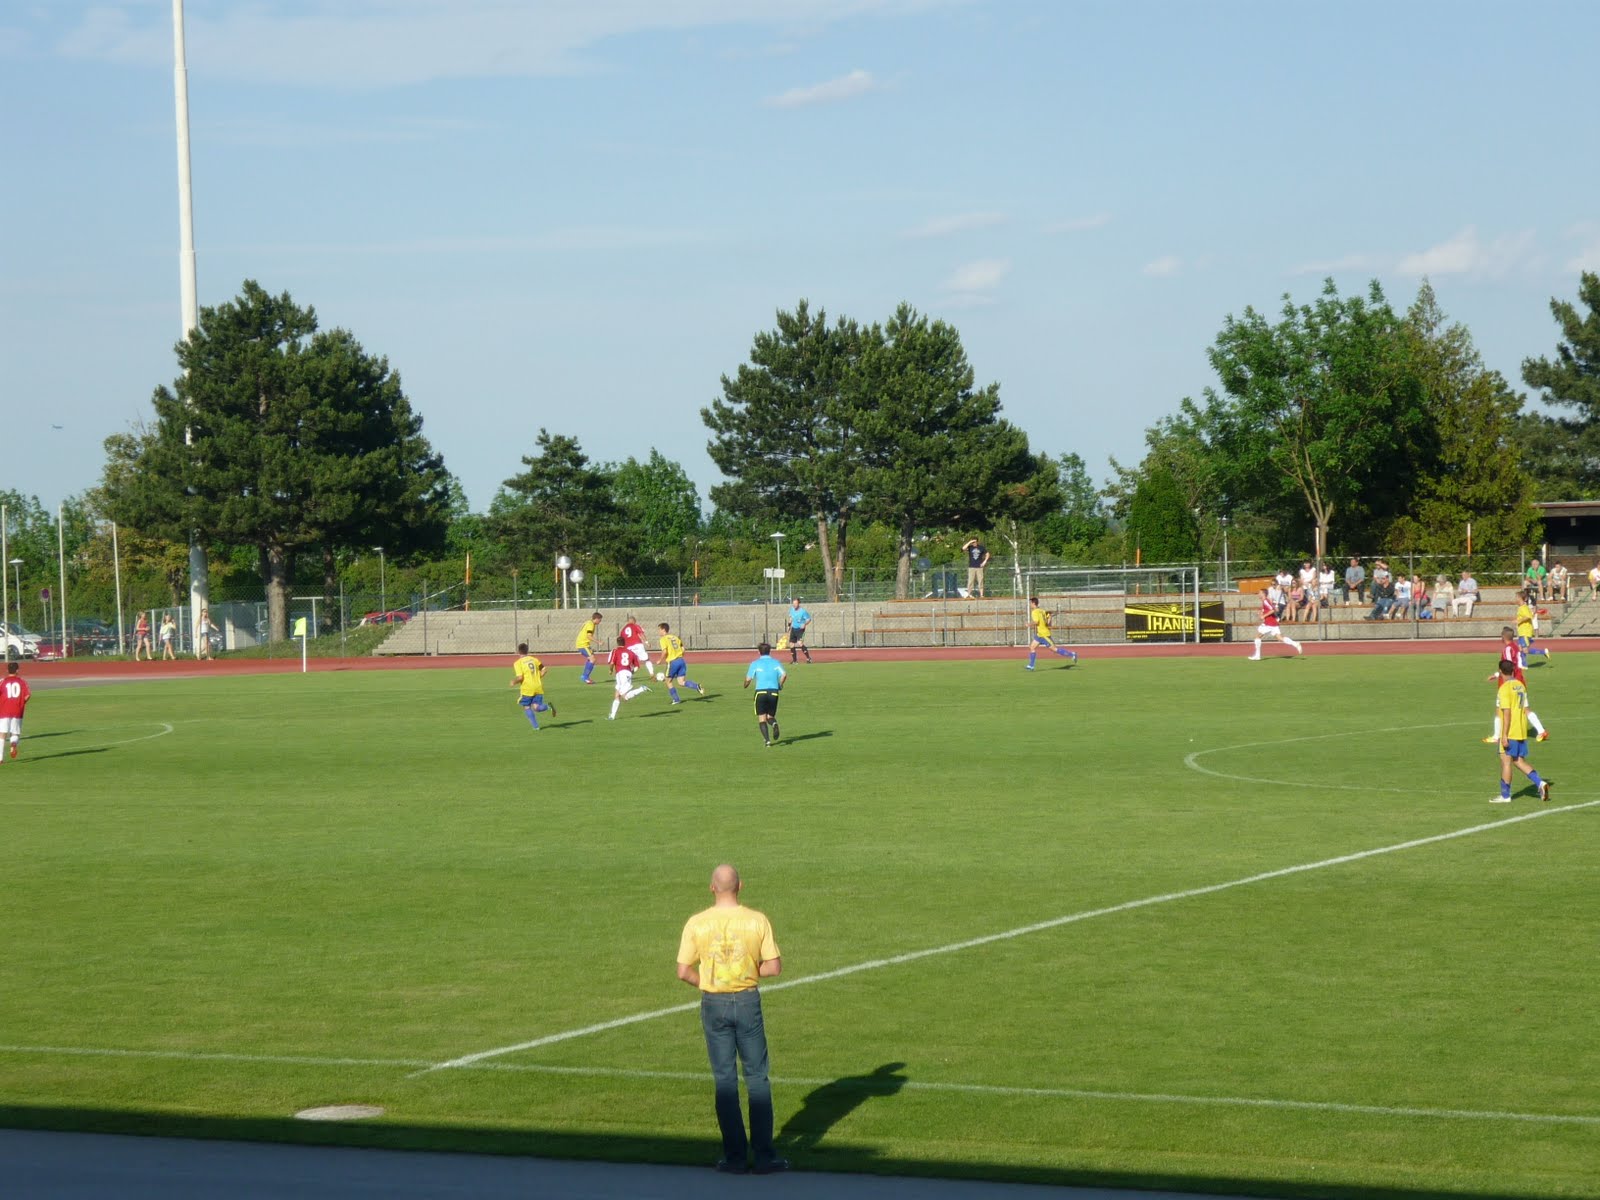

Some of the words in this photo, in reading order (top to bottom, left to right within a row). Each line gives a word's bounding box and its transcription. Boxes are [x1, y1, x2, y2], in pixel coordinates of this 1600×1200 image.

[1149, 614, 1197, 630] THANNE
[625, 626, 632, 638] 9
[621, 652, 630, 667] 8
[528, 662, 535, 674] 9
[5, 682, 21, 699] 10
